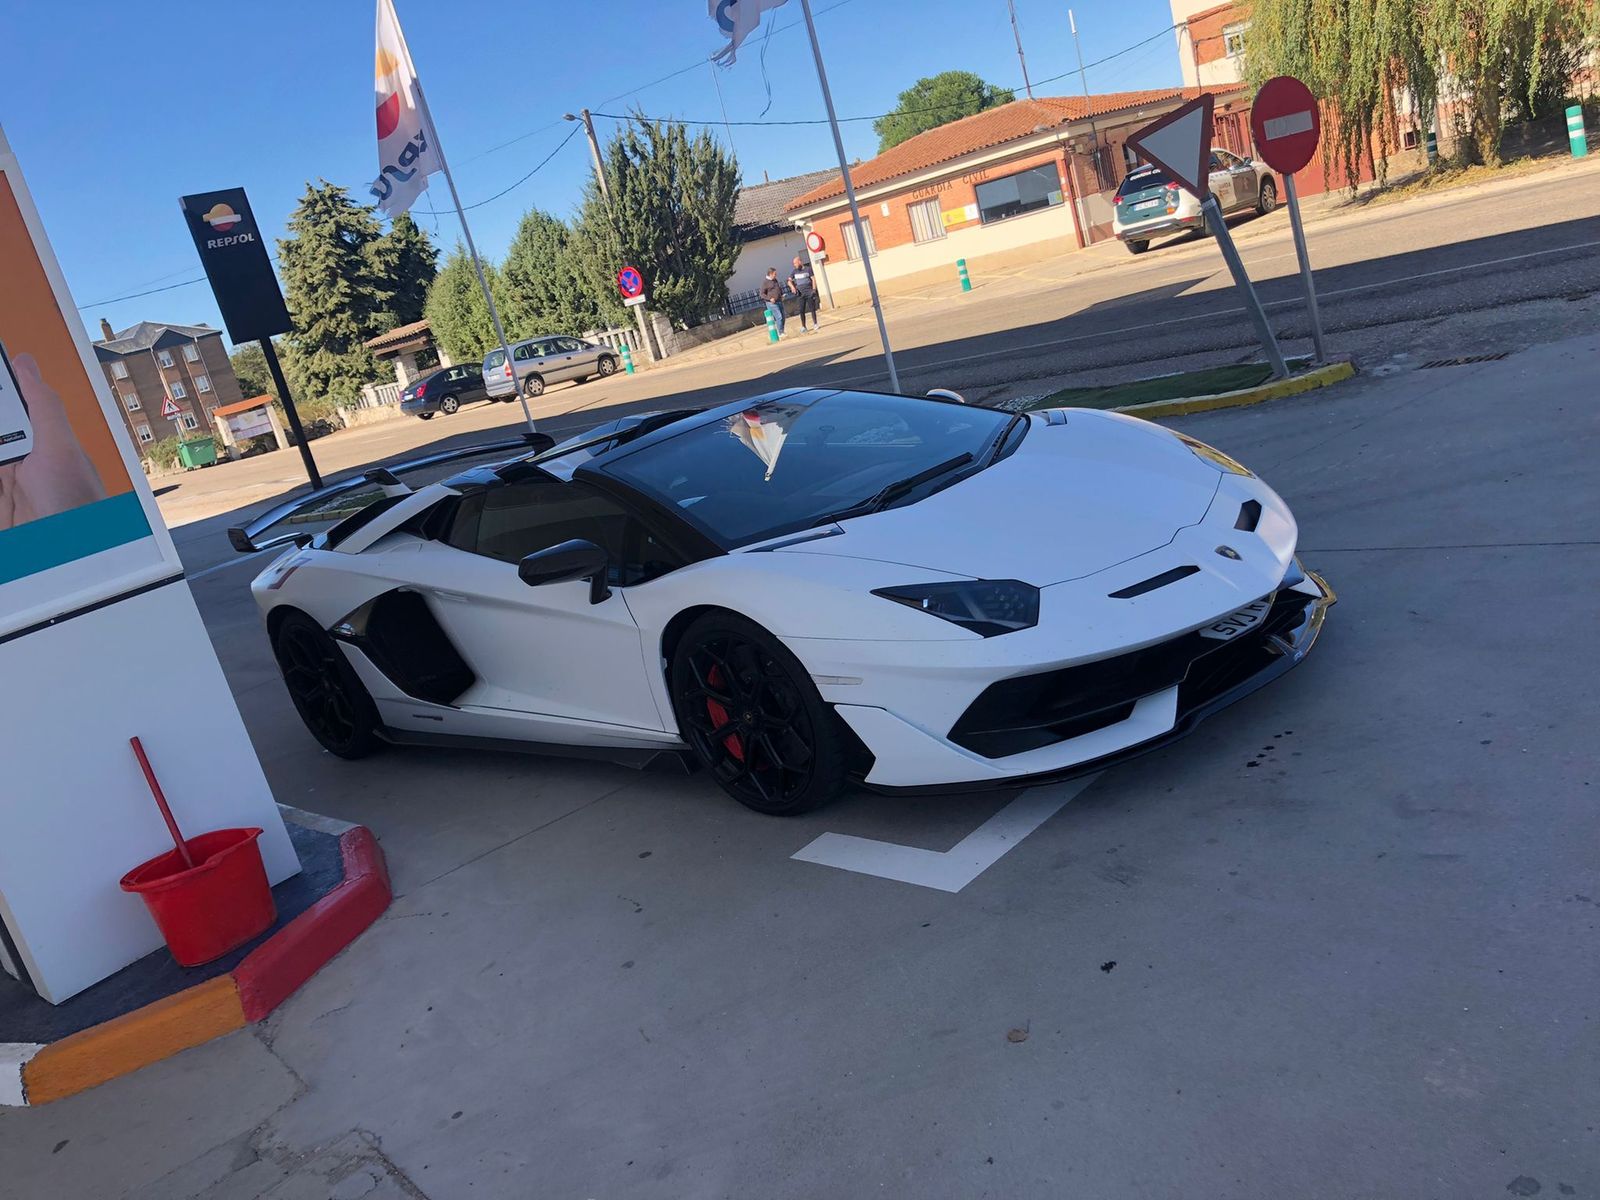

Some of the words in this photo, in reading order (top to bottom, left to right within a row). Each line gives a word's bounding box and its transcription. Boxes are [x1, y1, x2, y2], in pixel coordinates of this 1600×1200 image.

[912, 181, 952, 199] GUARDIA
[962, 169, 989, 184] CIVIL
[207, 232, 255, 249] REPSOL
